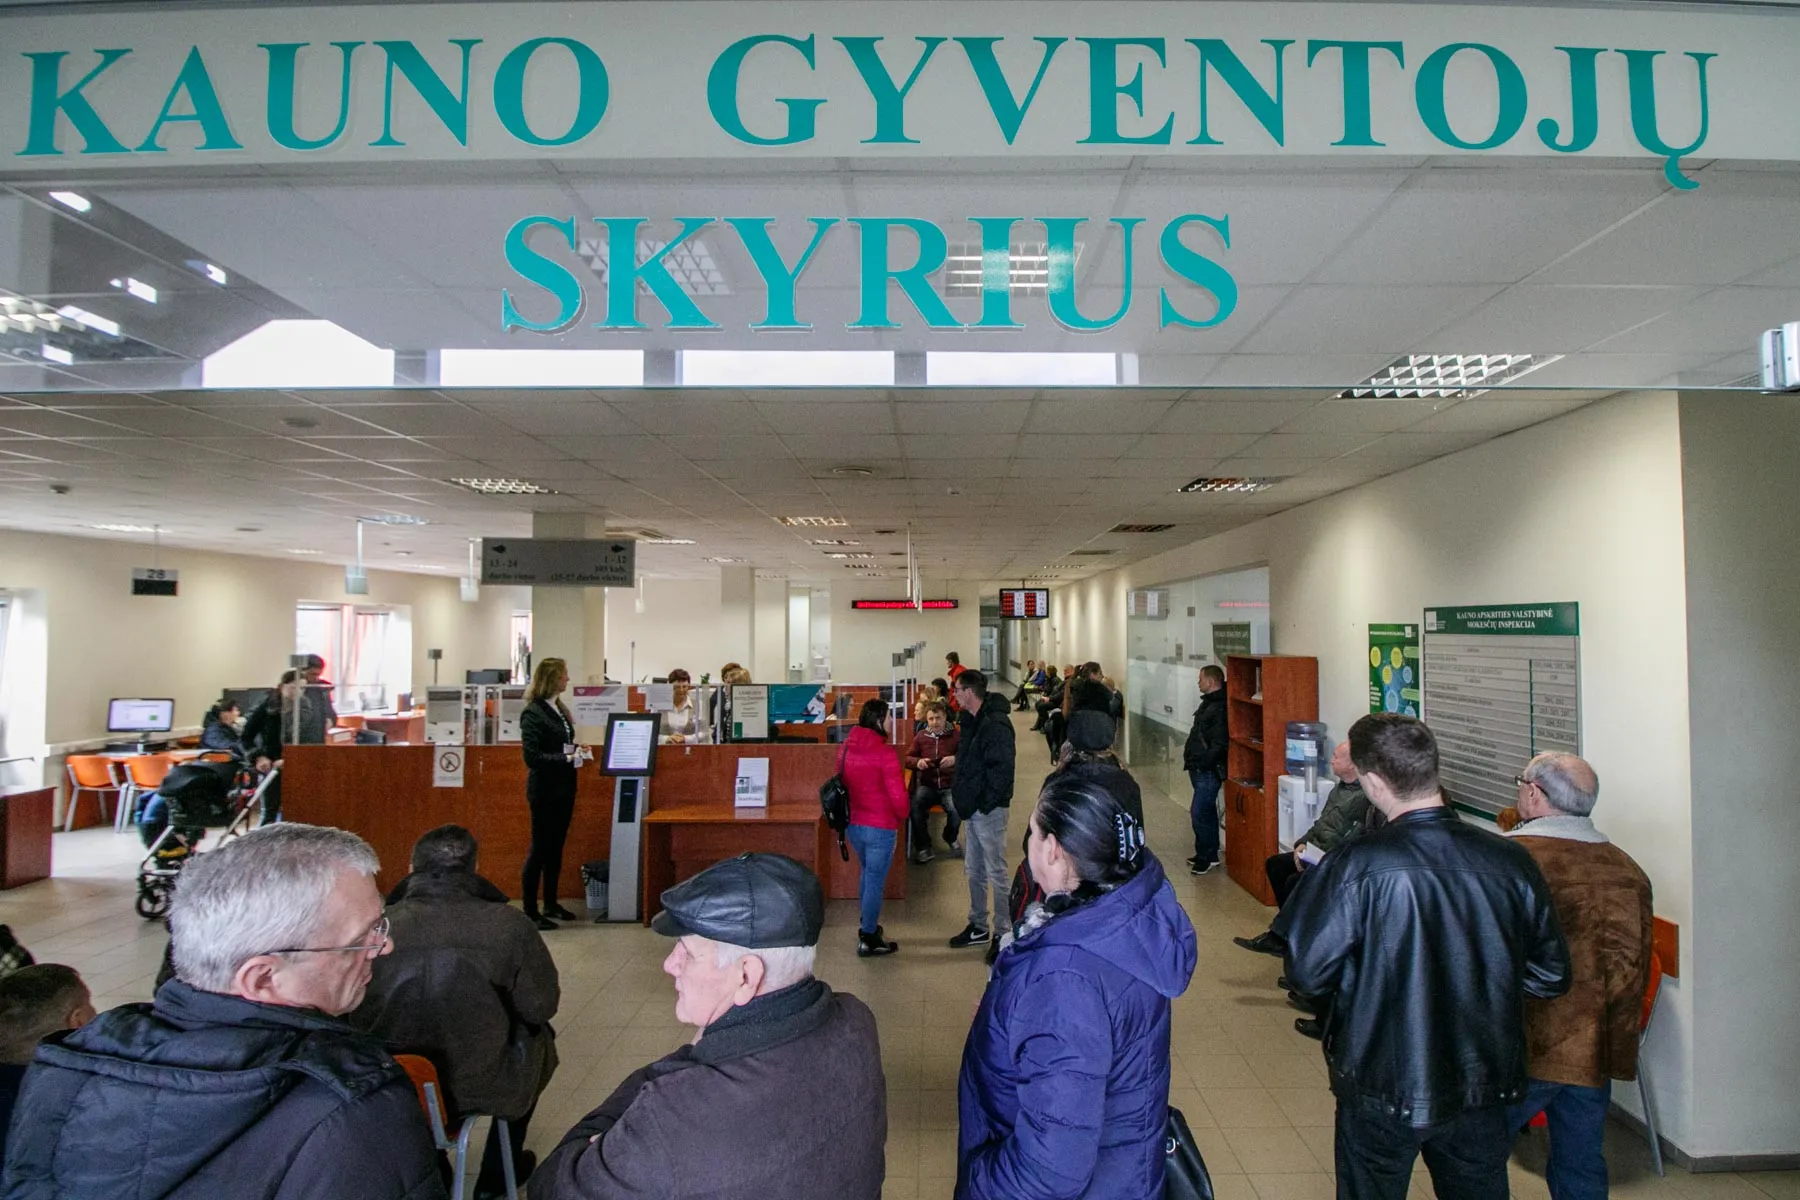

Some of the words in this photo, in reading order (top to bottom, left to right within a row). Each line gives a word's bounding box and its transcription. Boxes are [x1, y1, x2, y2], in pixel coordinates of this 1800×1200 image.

[14, 37, 611, 157] KAUNO
[705, 33, 1719, 191] GYVENTOJŲ
[501, 213, 1239, 331] SKYRIUS
[1456, 611, 1477, 620] KAUNO
[1477, 610, 1511, 619] APSKRITIES
[1498, 620, 1536, 629] INSPEKCIJA
